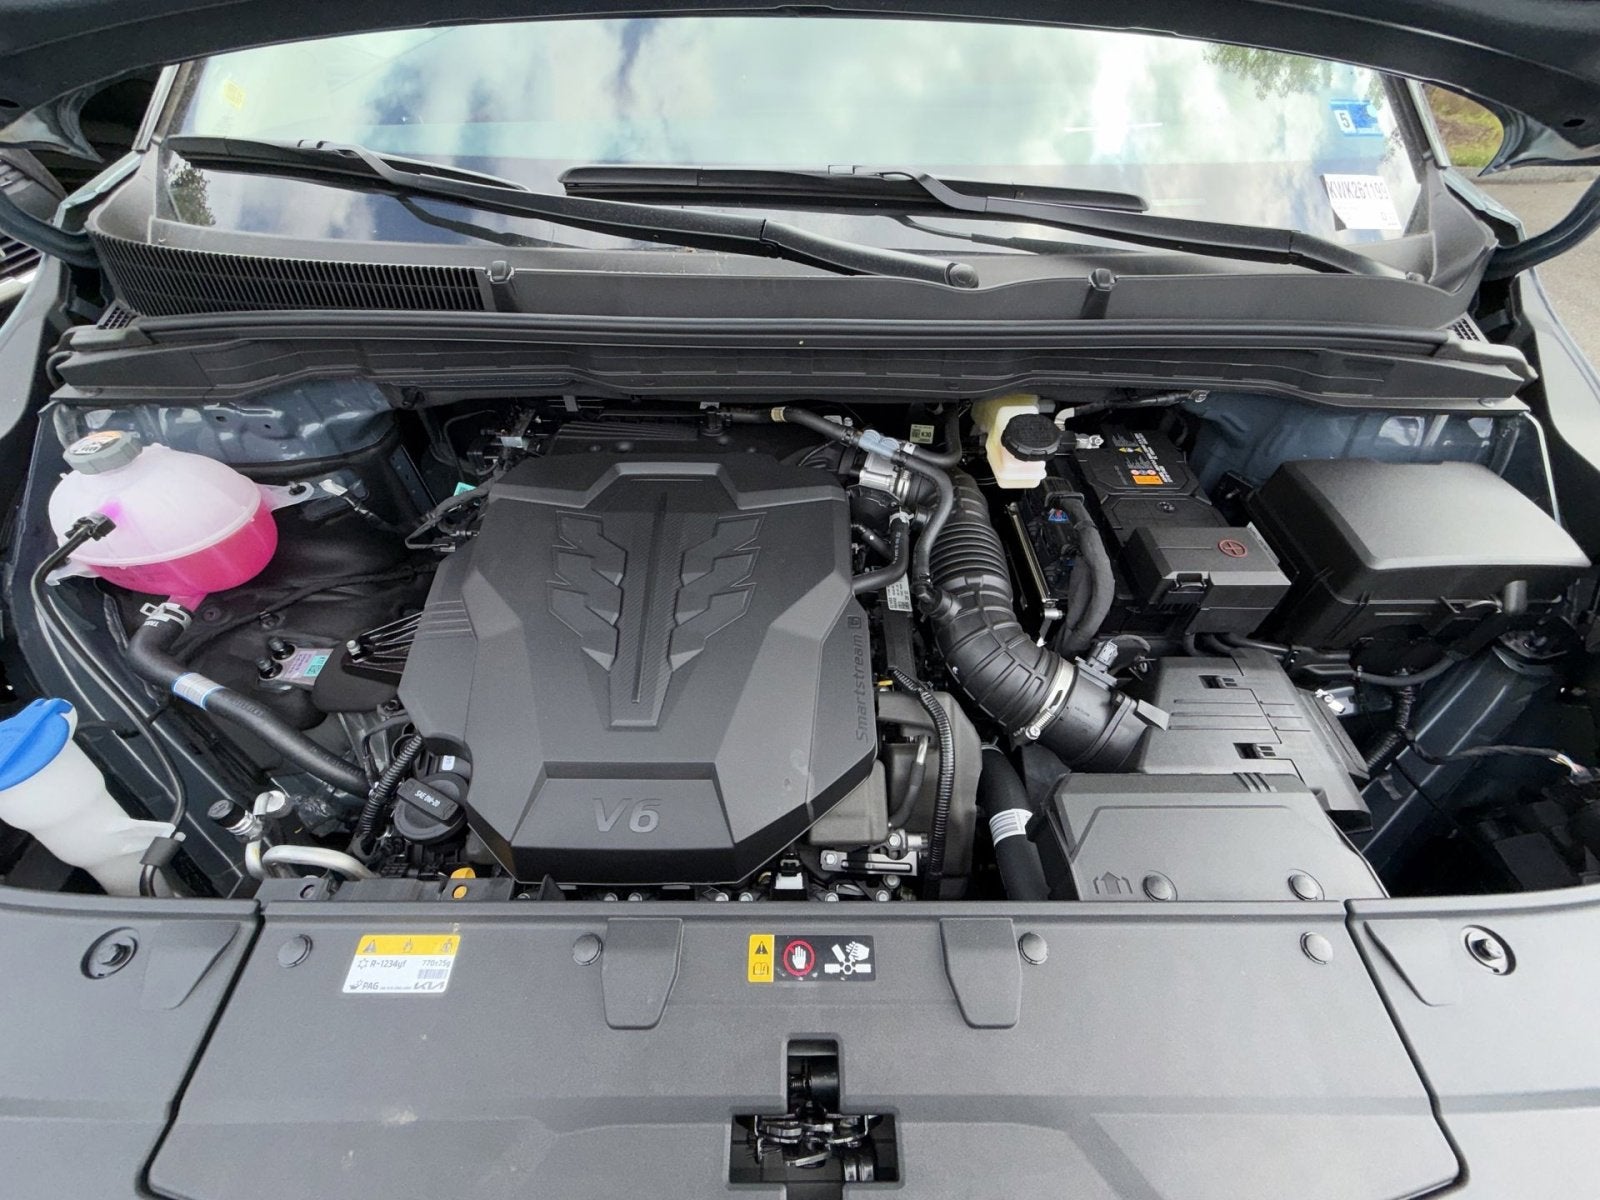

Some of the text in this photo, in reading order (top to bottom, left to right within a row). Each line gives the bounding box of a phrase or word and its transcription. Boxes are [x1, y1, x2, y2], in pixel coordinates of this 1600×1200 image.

[1339, 112, 1350, 128] 5
[853, 634, 868, 742] Smartstream
[592, 797, 661, 833] V6
[369, 959, 407, 969] R-1234yf
[361, 982, 379, 990] PAG
